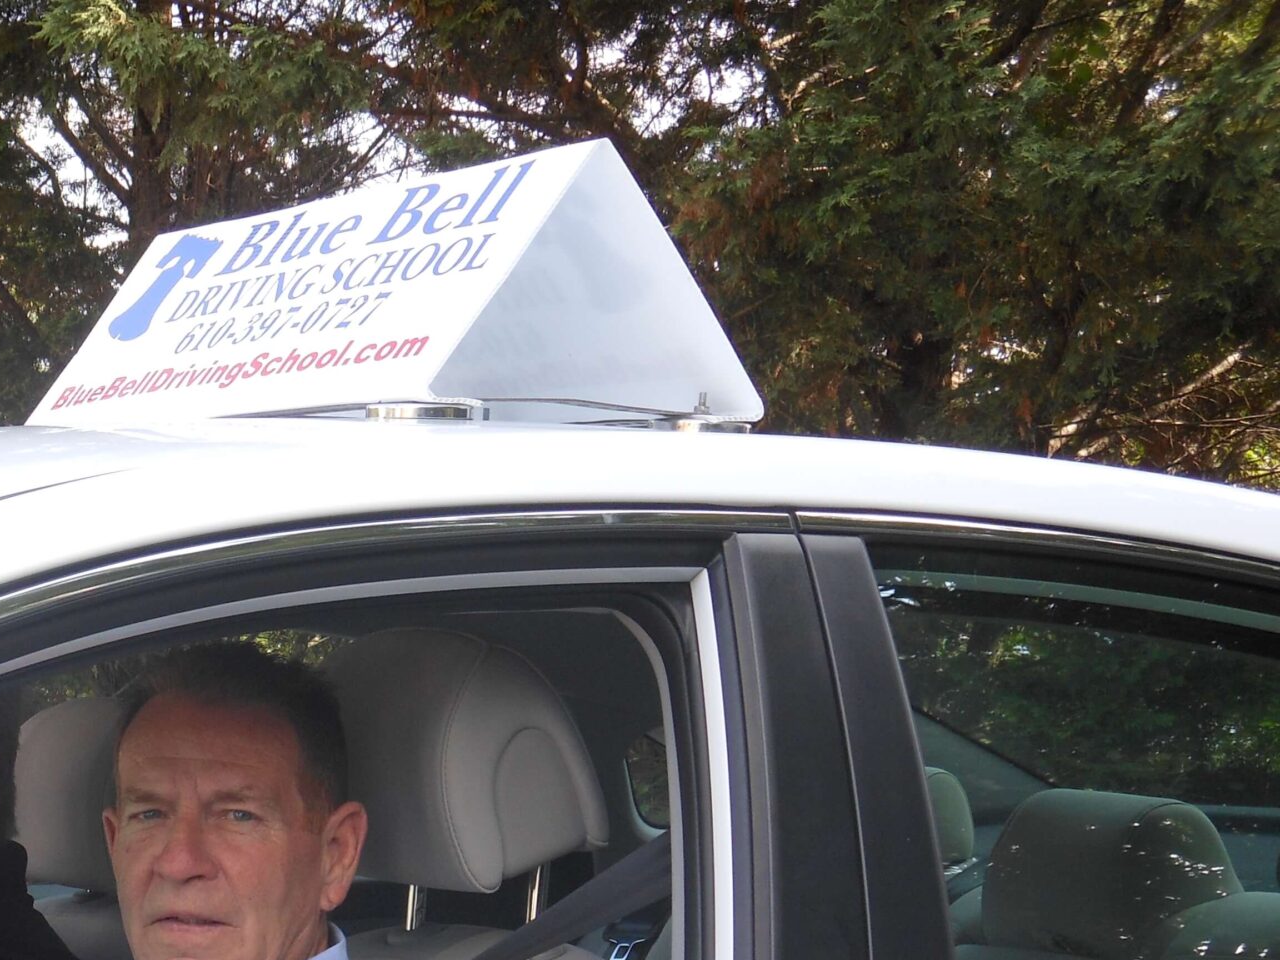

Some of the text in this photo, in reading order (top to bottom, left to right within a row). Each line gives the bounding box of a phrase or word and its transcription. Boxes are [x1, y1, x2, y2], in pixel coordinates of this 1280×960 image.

[214, 159, 536, 276] Blue Bell
[164, 233, 496, 323] DRIVING SCHOOL
[174, 291, 392, 354] 610-397-0727
[51, 336, 430, 410] BlueBellDrivingSchool.com
